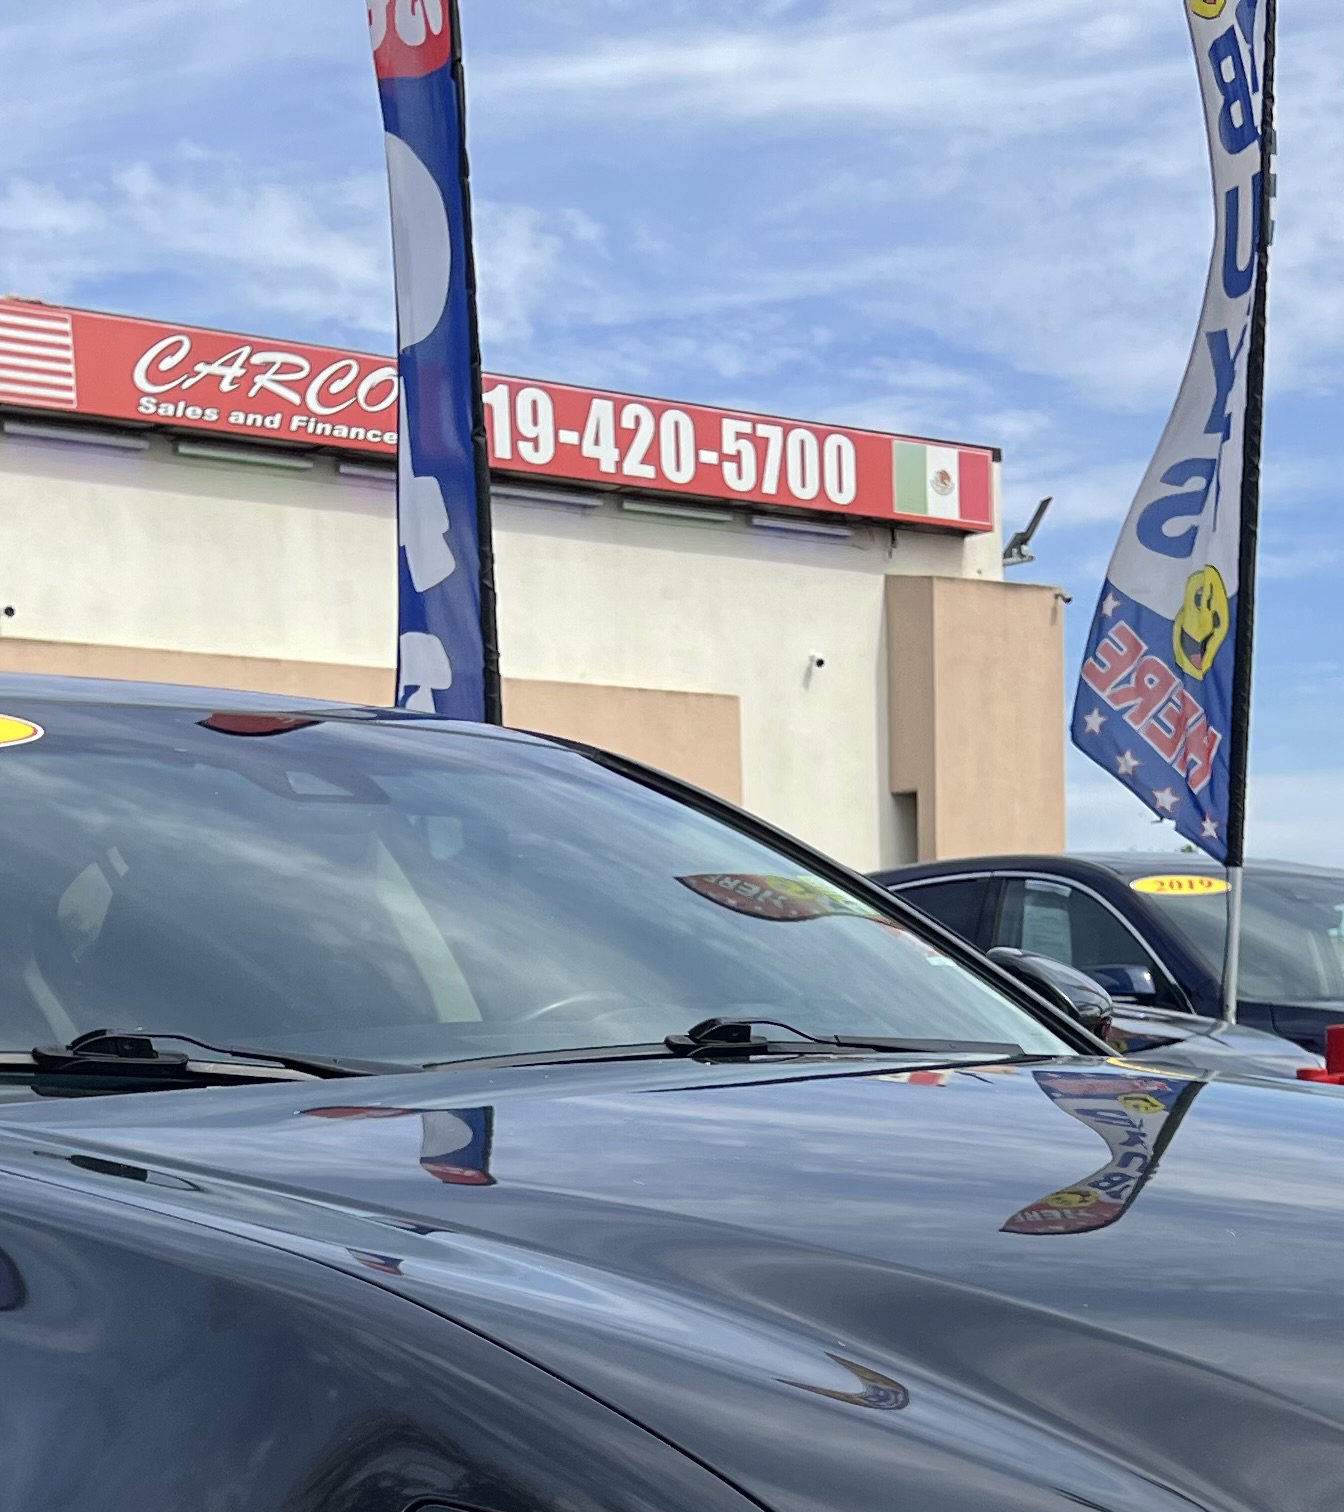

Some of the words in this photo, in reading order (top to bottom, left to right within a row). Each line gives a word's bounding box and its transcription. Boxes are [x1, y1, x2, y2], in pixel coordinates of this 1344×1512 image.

[132, 334, 399, 416] CARCO
[138, 396, 220, 422] Sales
[227, 408, 283, 430] and
[289, 416, 399, 445] Finance
[483, 384, 857, 505] 19-420-5700
[1155, 879, 1213, 892] 2019
